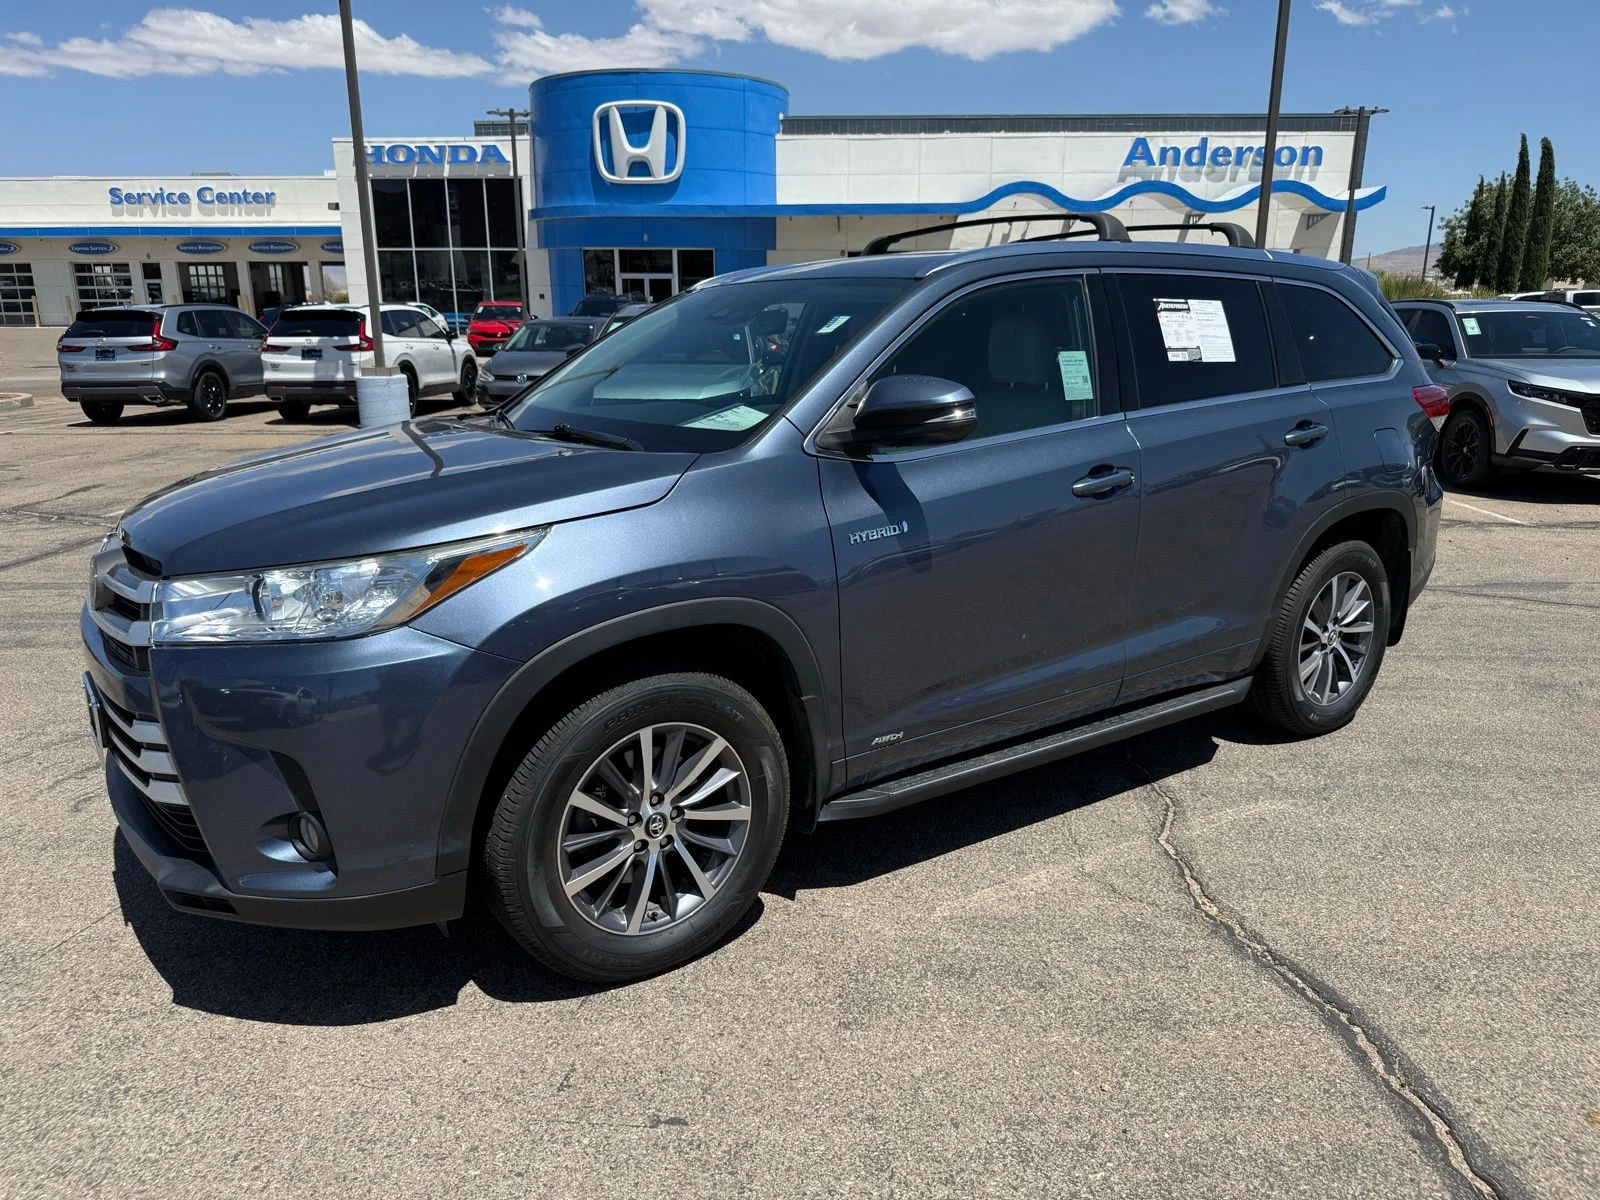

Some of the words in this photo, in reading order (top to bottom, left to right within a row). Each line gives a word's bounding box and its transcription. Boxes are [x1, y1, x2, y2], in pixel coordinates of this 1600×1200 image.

[364, 144, 511, 165] HONDA
[1123, 137, 1323, 167] Anderson
[108, 187, 191, 205] Service
[197, 186, 276, 205] Center
[849, 524, 901, 545] HYBRID
